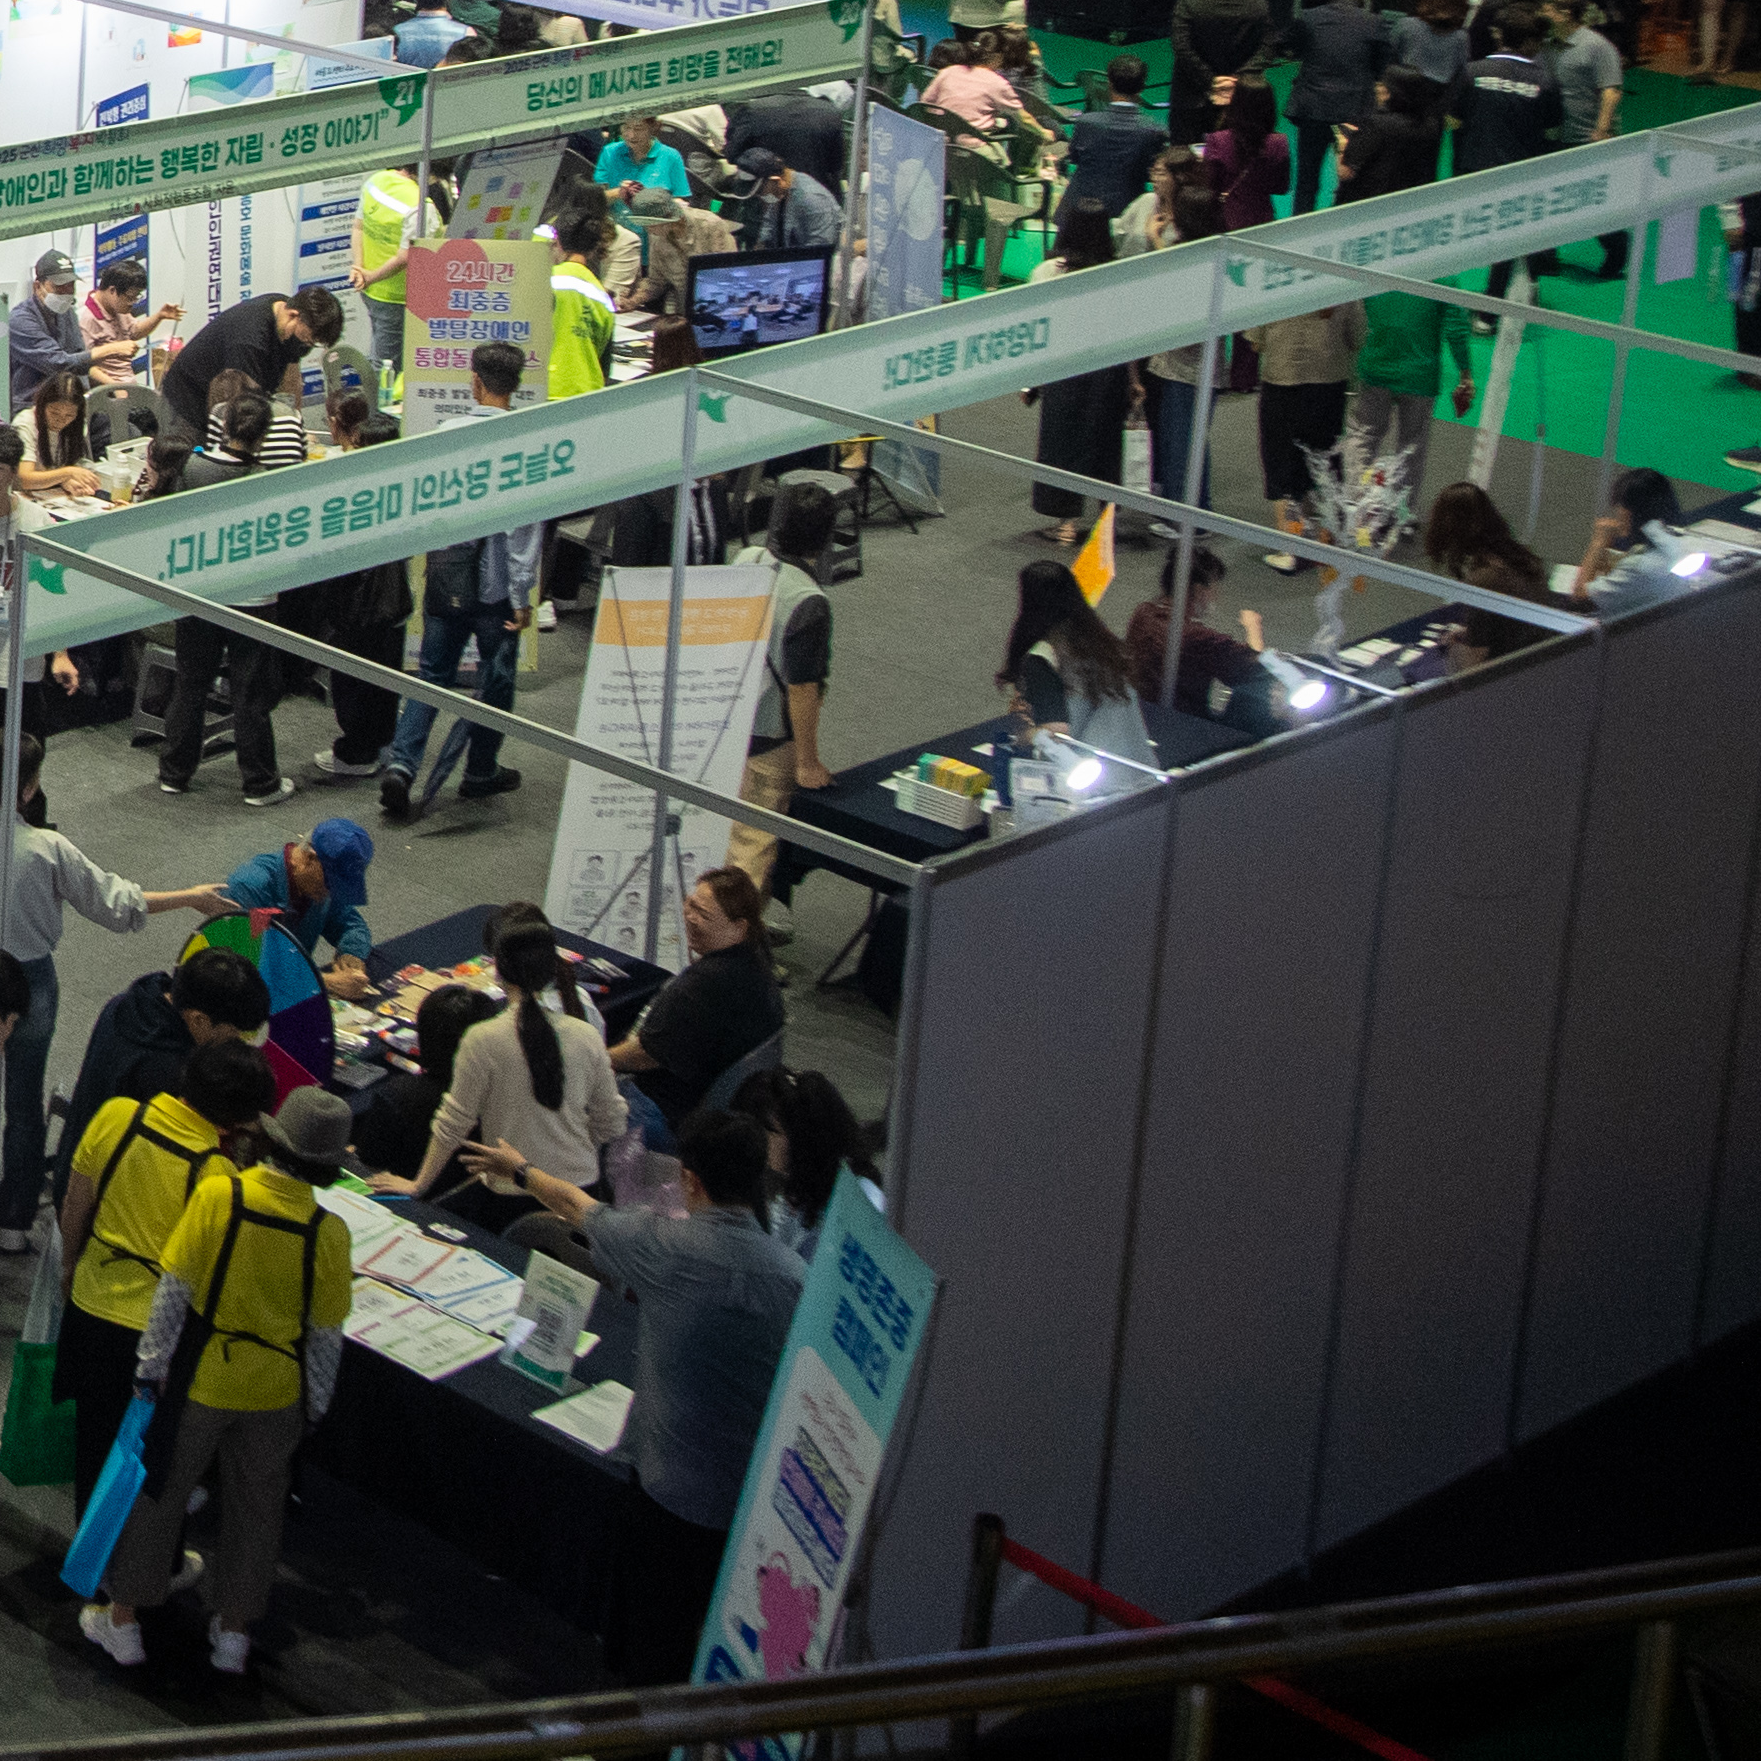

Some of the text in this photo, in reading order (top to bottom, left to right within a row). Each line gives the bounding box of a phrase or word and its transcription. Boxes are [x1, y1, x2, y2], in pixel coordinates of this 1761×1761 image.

[526, 78, 580, 112] 당신의
[587, 65, 661, 102] 메시지로
[666, 49, 720, 84] 희망을
[725, 38, 783, 74] 전해요!
[73, 153, 154, 195] 함께하는
[160, 142, 221, 179] 행복한
[225, 131, 264, 167] 자립
[281, 122, 319, 157] 성장
[445, 260, 516, 284] 24시간
[447, 290, 511, 313] 최중증
[428, 319, 531, 342] 발달장애인
